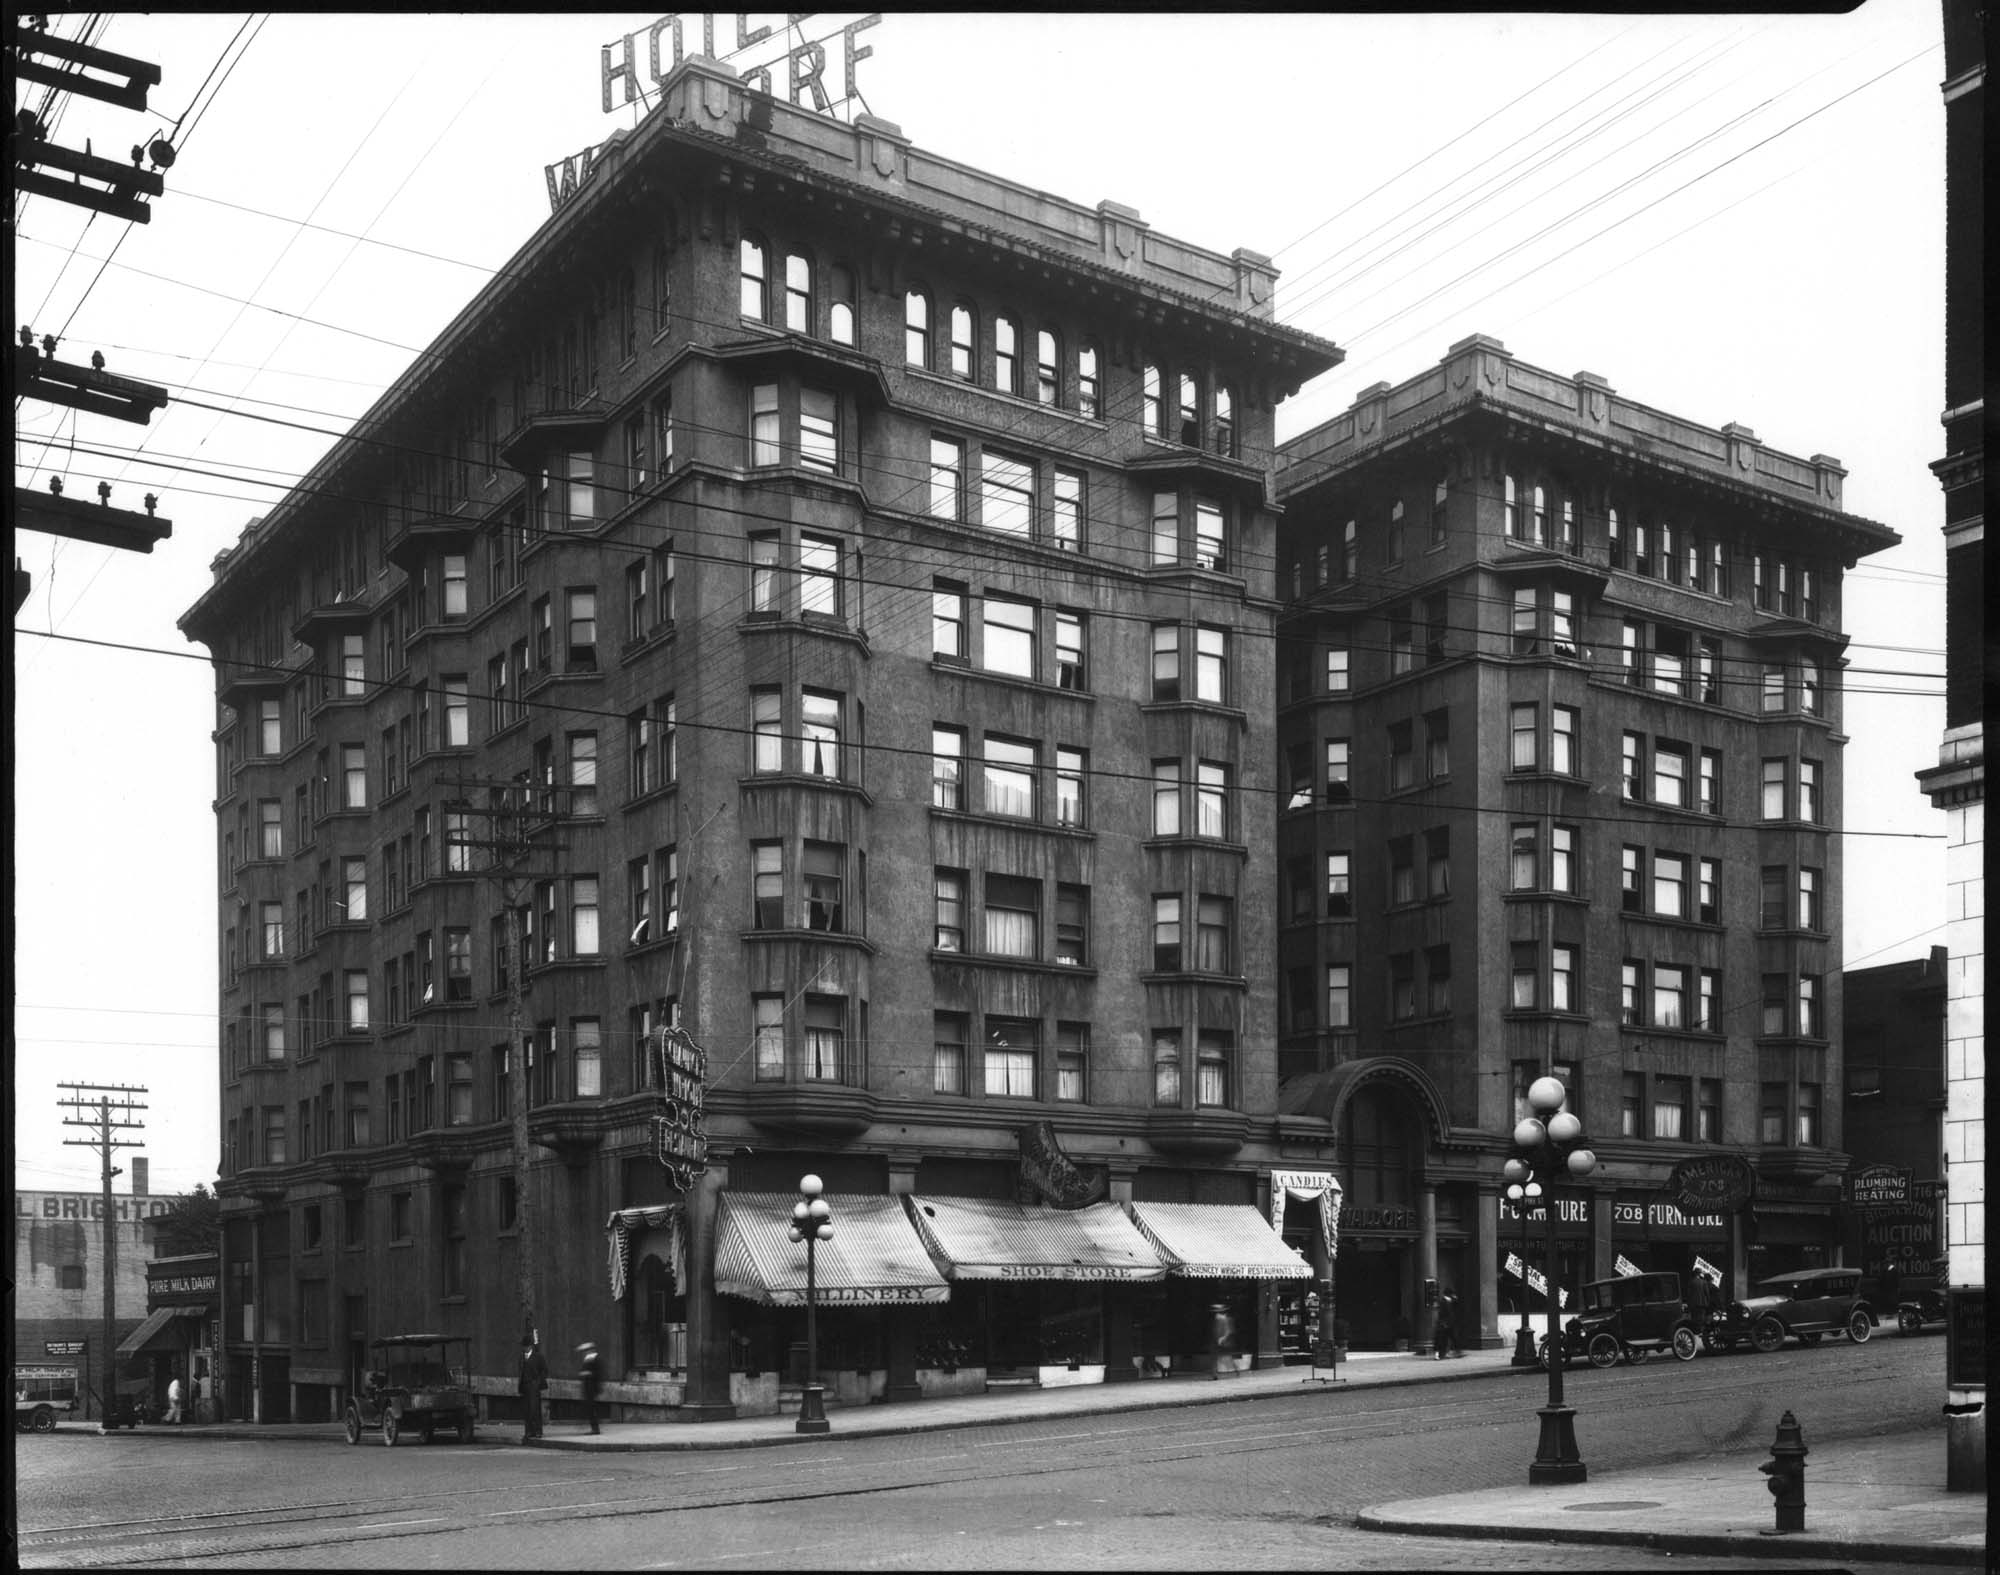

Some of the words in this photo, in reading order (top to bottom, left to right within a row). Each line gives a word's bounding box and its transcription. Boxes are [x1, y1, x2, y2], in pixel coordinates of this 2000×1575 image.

[1280, 1175, 1333, 1187] CANDIES
[1854, 1177, 1906, 1190] PLUMBING
[1855, 1190, 1905, 1201] HEATING
[1614, 1206, 1643, 1221] 708
[1867, 1223, 1933, 1244] AUCTION
[1001, 1265, 1055, 1278] SHOE
[1063, 1267, 1131, 1279] STORE
[1220, 1266, 1245, 1276] WRIGHT
[1247, 1267, 1292, 1276] RESTAURANTS
[150, 1279, 169, 1294] PURE
[170, 1278, 190, 1292] MILK
[191, 1275, 216, 1290] DAIRY
